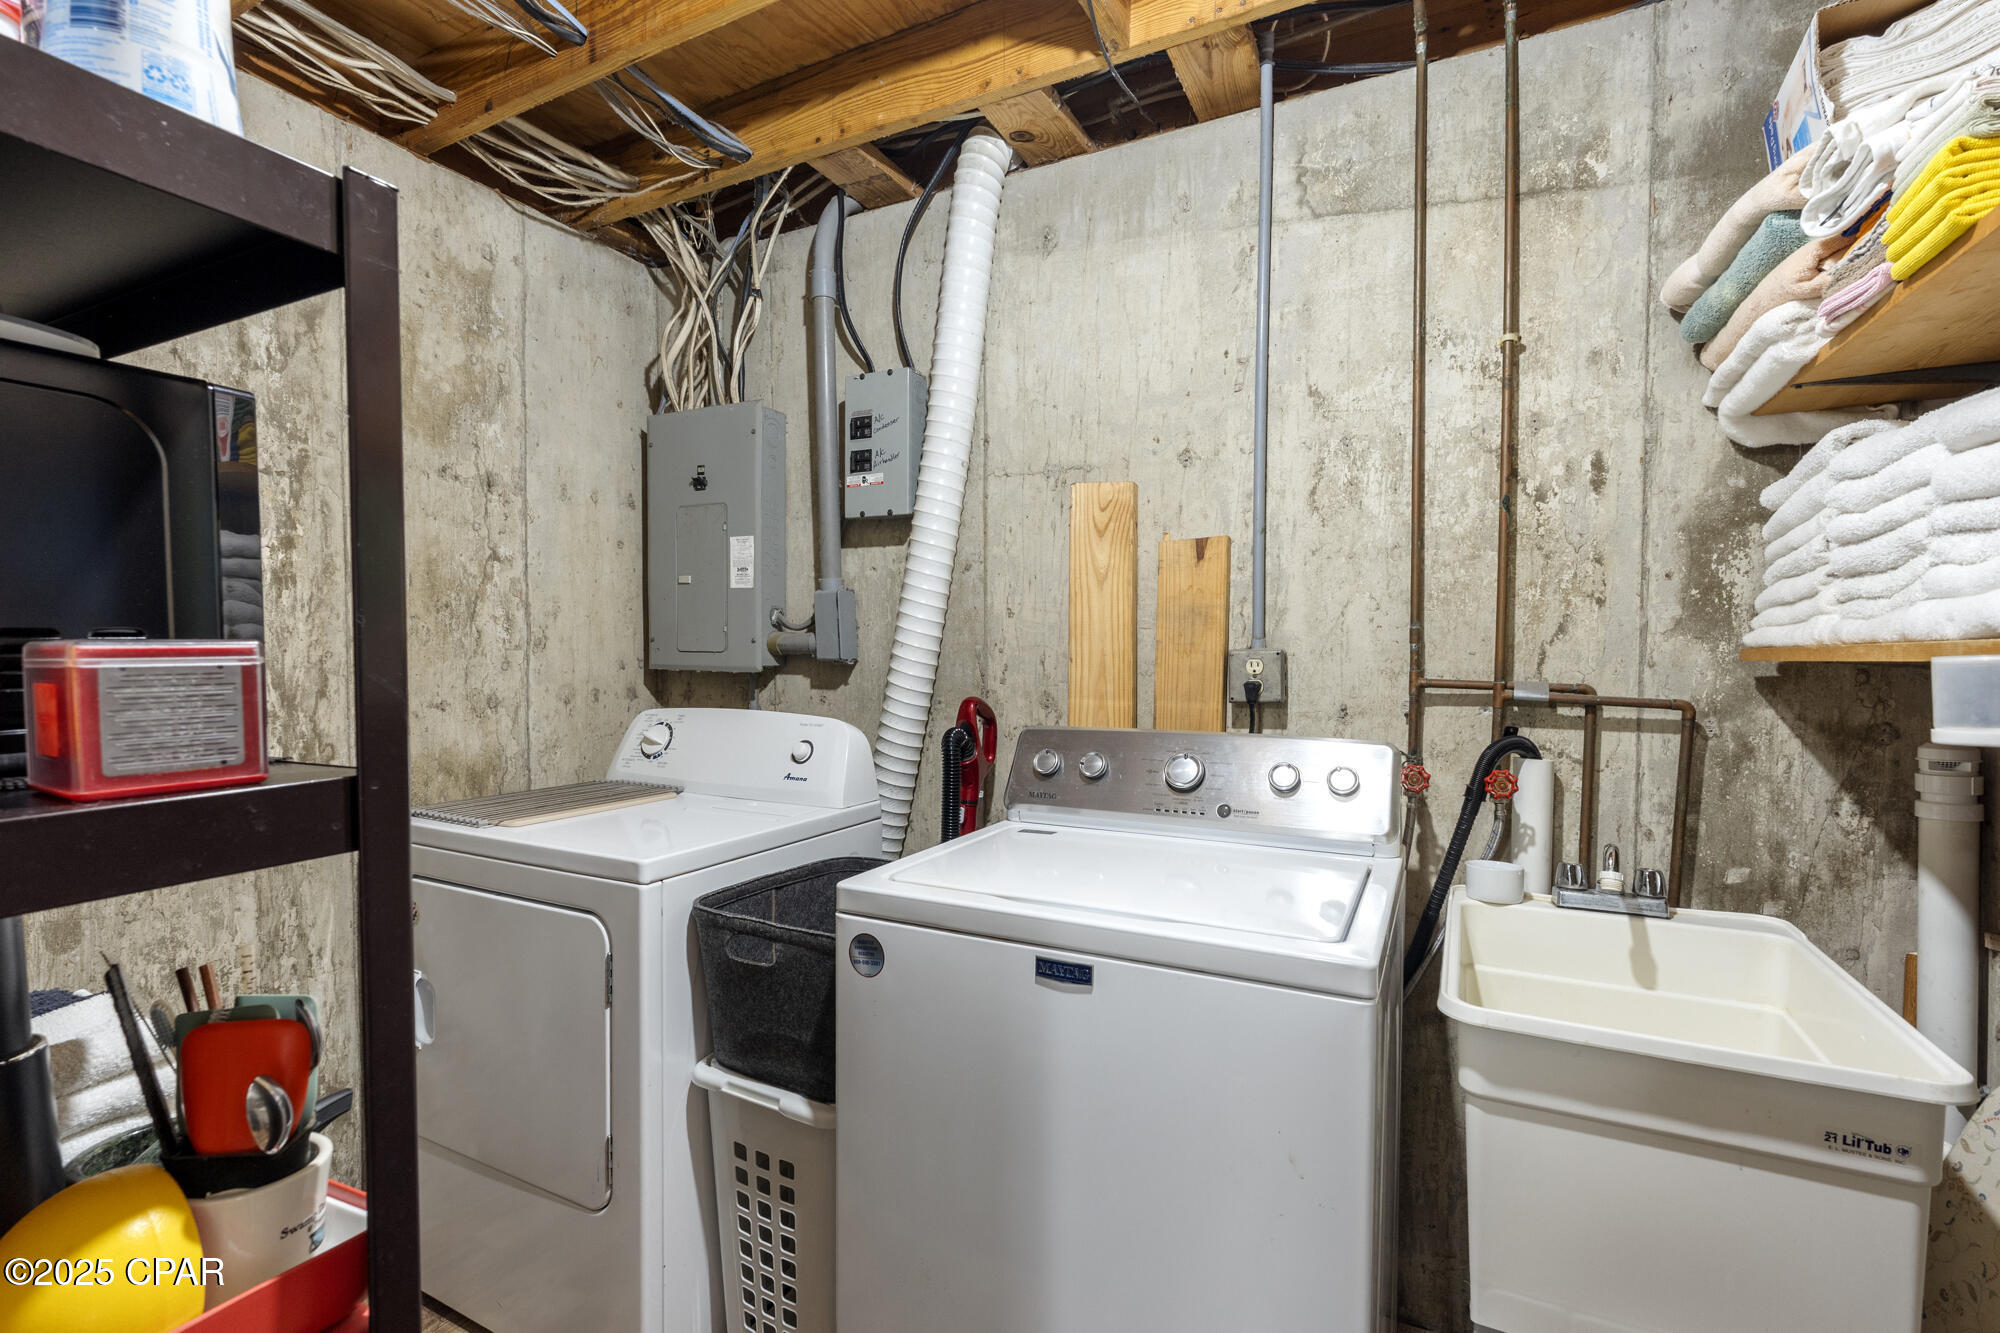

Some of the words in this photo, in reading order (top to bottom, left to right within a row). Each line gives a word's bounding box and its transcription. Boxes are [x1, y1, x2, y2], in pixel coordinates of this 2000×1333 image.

[784, 772, 808, 782] Amana
[1028, 791, 1057, 800] MAYTAG
[1038, 961, 1089, 980] MAYTAG
[1824, 1133, 1838, 1144] 21
